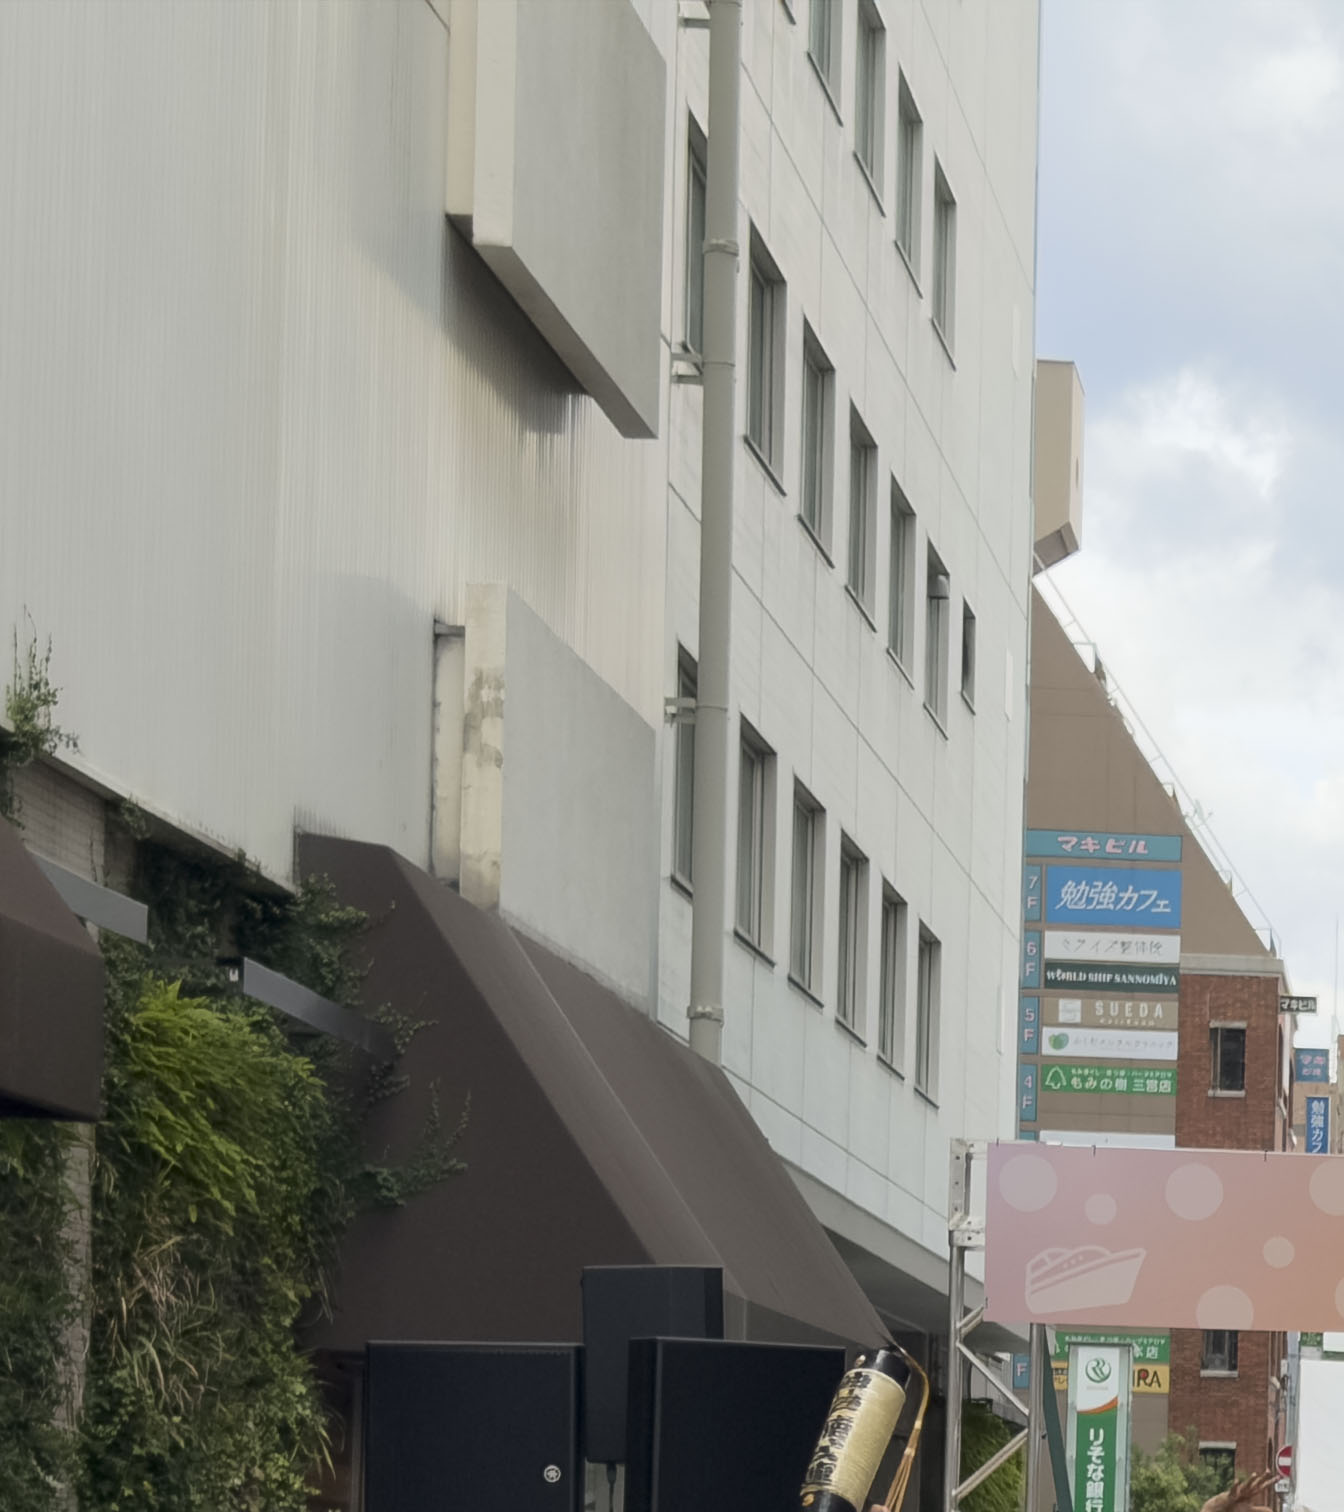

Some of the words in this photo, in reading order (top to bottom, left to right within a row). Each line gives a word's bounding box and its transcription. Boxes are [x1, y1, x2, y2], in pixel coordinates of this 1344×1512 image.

[1057, 836, 1149, 854] マキビル
[1055, 879, 1172, 913] 勉強カフェ
[1114, 972, 1177, 986] SANNOMIYA
[1095, 1002, 1163, 1019] SUEDA
